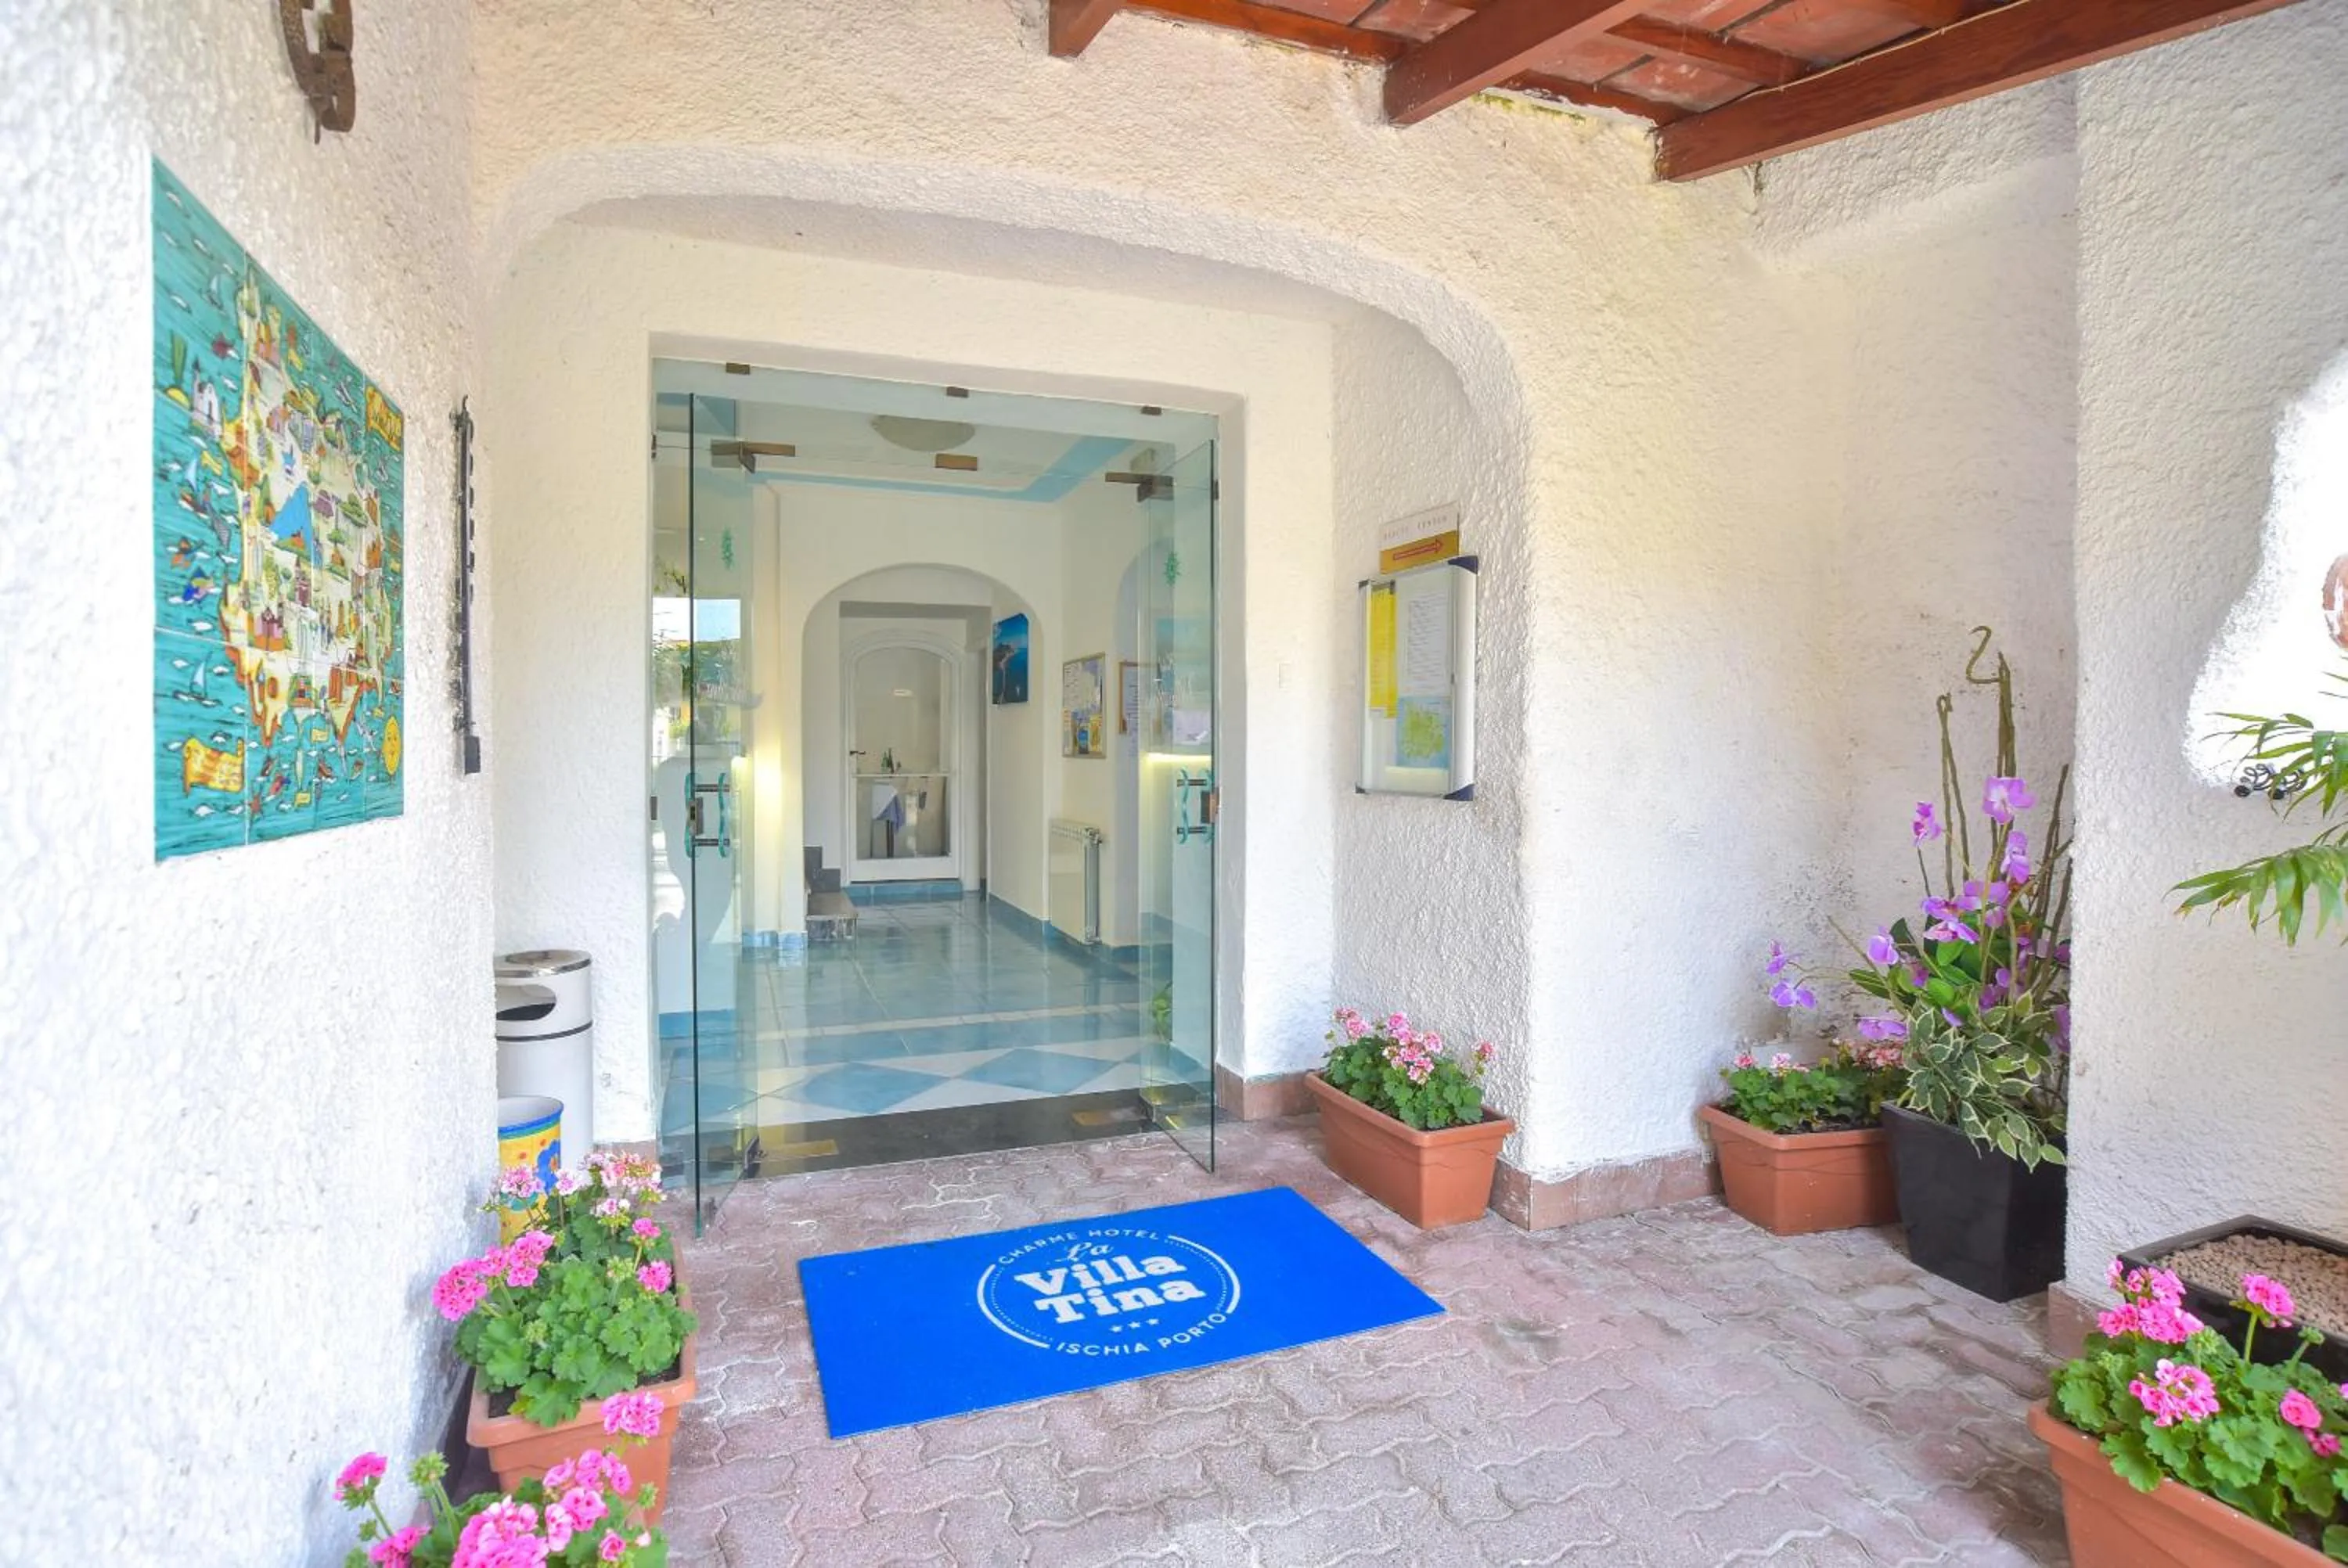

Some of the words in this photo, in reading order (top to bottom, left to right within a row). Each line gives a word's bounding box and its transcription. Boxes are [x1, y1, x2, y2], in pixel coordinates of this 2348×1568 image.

[999, 1232, 1078, 1264] CHARME
[1089, 1228, 1159, 1240] HOTEL
[1054, 1242, 1114, 1262] La
[1014, 1256, 1188, 1296] Villa
[1035, 1280, 1207, 1324] Tina
[1057, 1342, 1150, 1356] ISCHIA
[1158, 1313, 1227, 1348] PORTO
